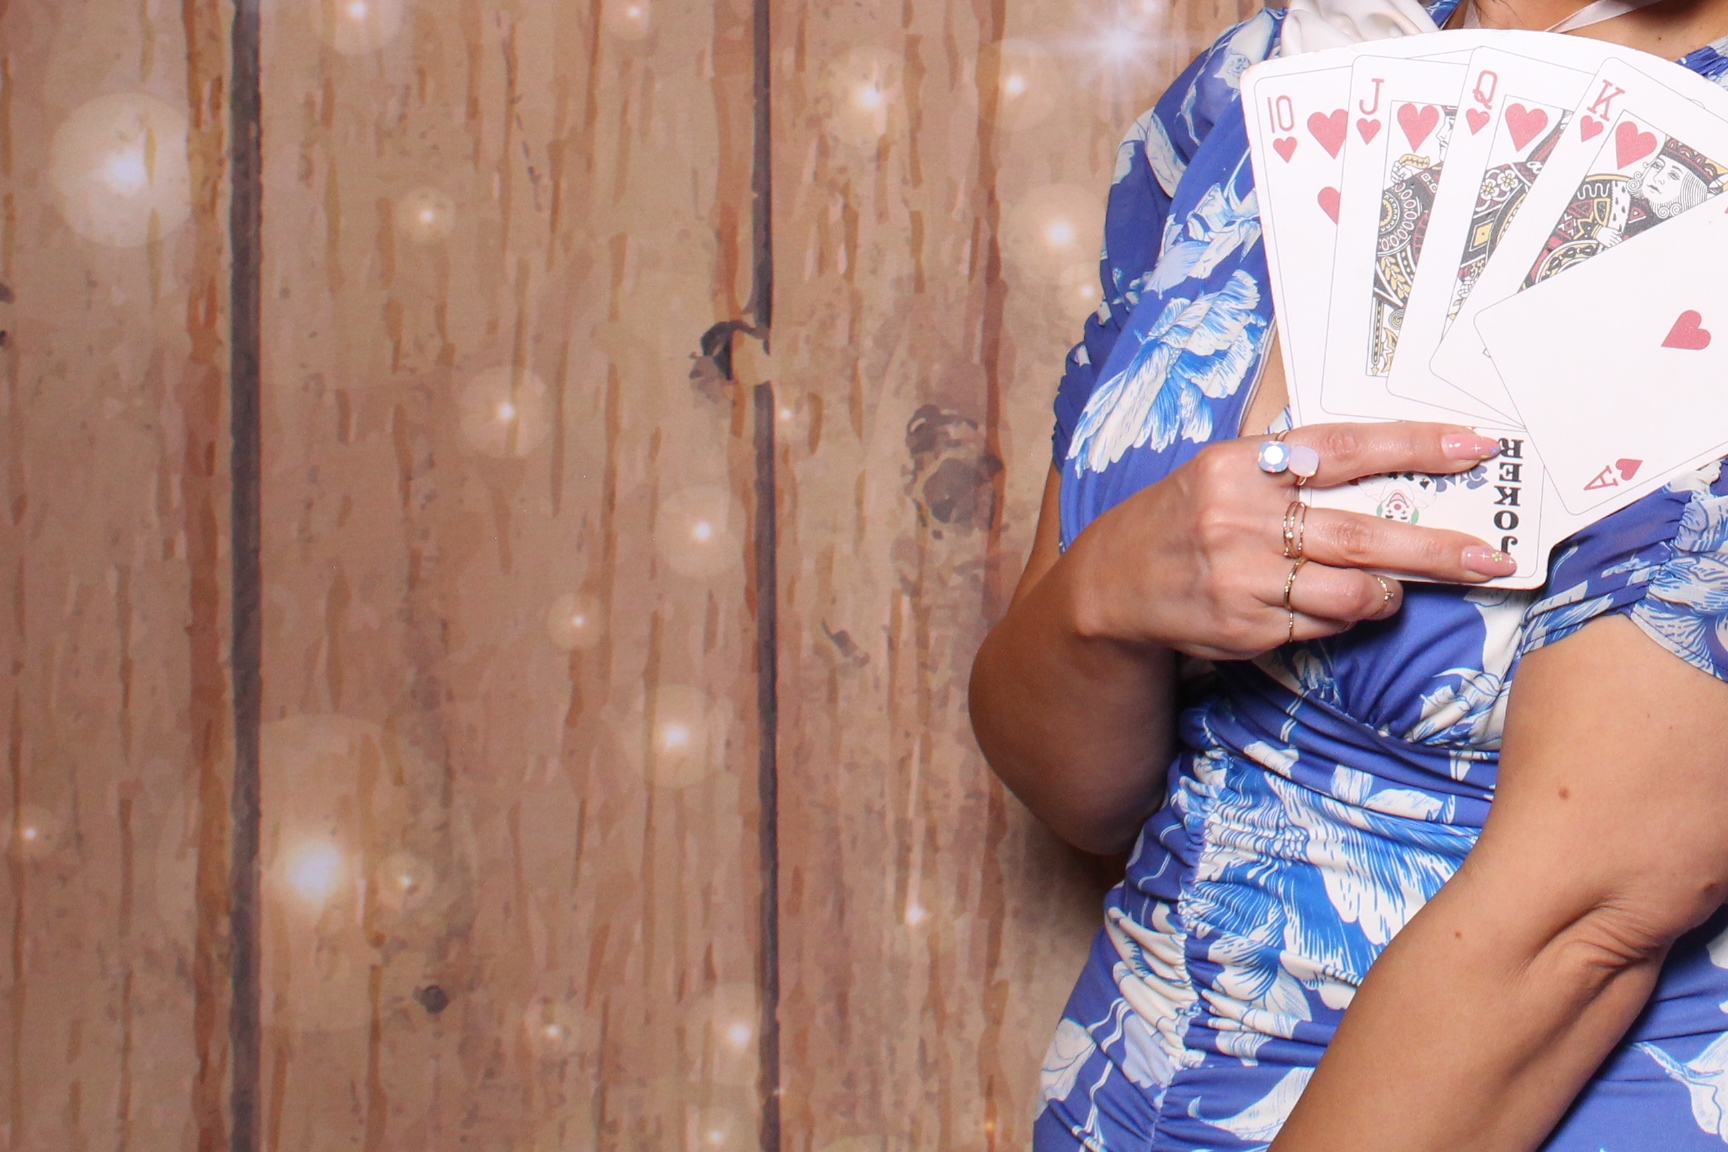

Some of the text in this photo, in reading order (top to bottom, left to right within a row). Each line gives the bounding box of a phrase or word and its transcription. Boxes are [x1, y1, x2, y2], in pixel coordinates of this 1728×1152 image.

[1359, 78, 1384, 115] J
[1473, 70, 1497, 110] Q
[1587, 79, 1625, 121] K
[1267, 95, 1294, 133] 10
[1493, 437, 1524, 556] JOKER
[1583, 464, 1619, 491] A
